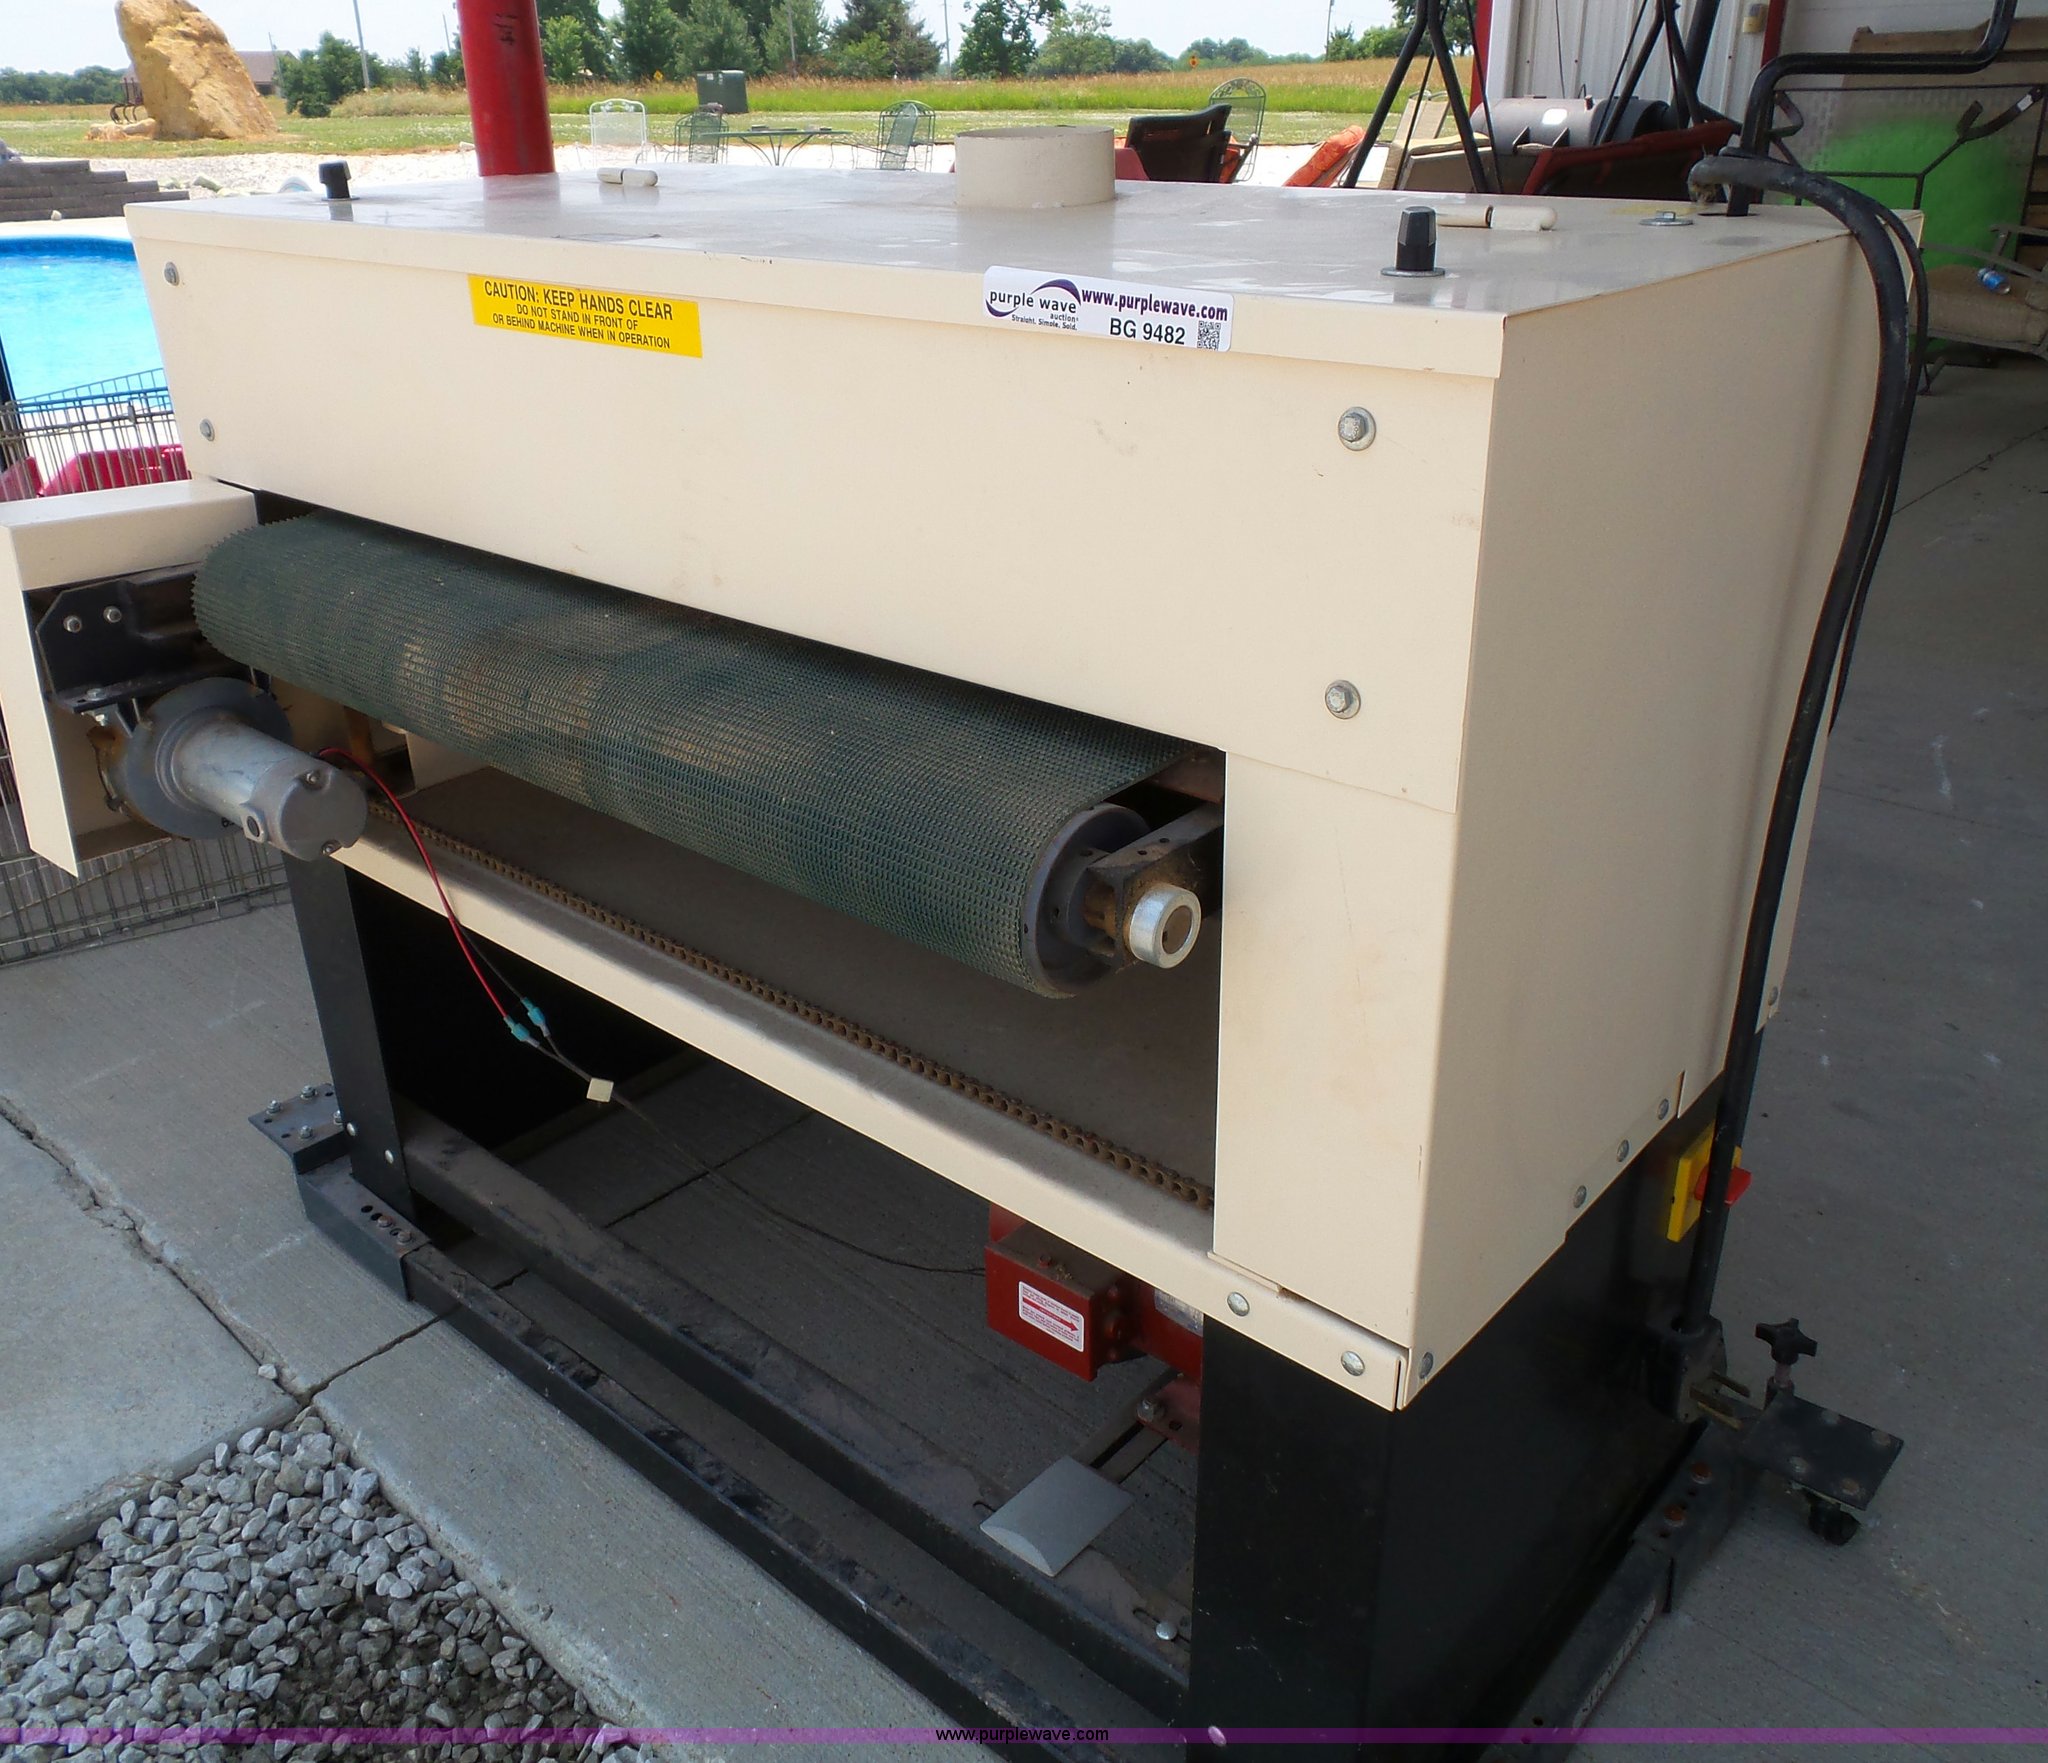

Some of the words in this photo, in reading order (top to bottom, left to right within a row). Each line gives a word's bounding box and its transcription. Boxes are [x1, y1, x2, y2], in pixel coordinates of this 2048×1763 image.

[485, 280, 539, 303] CAUTION:
[543, 288, 575, 307] KEEP
[580, 293, 624, 314] HANDS
[629, 299, 673, 320] CLEAR
[990, 291, 1034, 307] purple
[1039, 298, 1076, 313] wave
[1081, 289, 1228, 321] www.purplewave.com
[493, 313, 504, 324] OR
[506, 315, 535, 329] BEHIND
[538, 320, 576, 335] MACHINE
[578, 326, 604, 339] WHEN
[607, 329, 616, 341] IN
[618, 331, 670, 348] OPERATION
[516, 303, 528, 315] DO
[531, 305, 547, 318] NOT
[551, 308, 579, 323] STAND
[582, 313, 591, 324] IN
[594, 314, 622, 328] FRONT
[626, 319, 638, 330] OF
[1062, 322, 1078, 331] Sold.
[1110, 317, 1137, 339] BG
[1142, 322, 1186, 345] 9482
